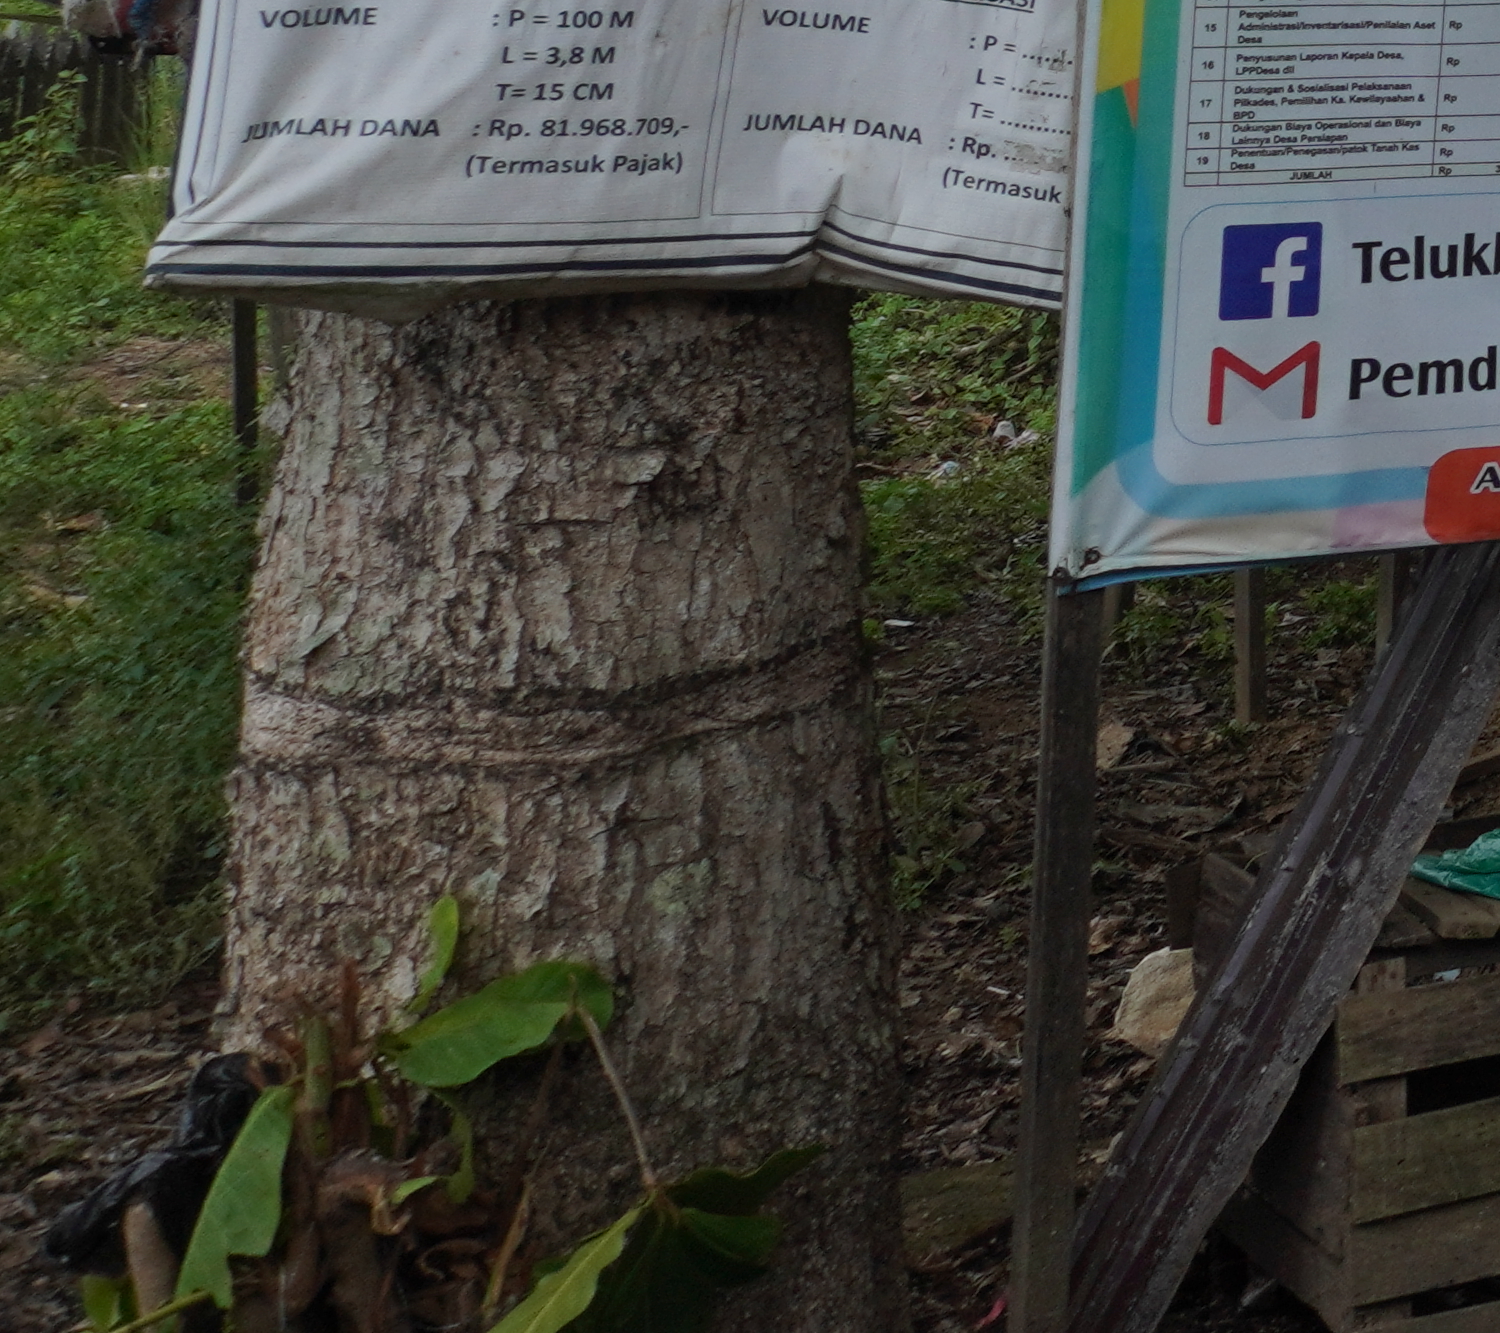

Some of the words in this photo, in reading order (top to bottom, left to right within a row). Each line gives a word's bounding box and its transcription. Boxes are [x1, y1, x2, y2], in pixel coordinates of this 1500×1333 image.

[242, 118, 351, 143] JUMLAH
[359, 119, 440, 137] DANA
[488, 119, 530, 141] Rp.
[540, 117, 689, 137] 81.968.709,-
[466, 155, 604, 177] (Termasuk
[613, 152, 682, 176] Pajak)
